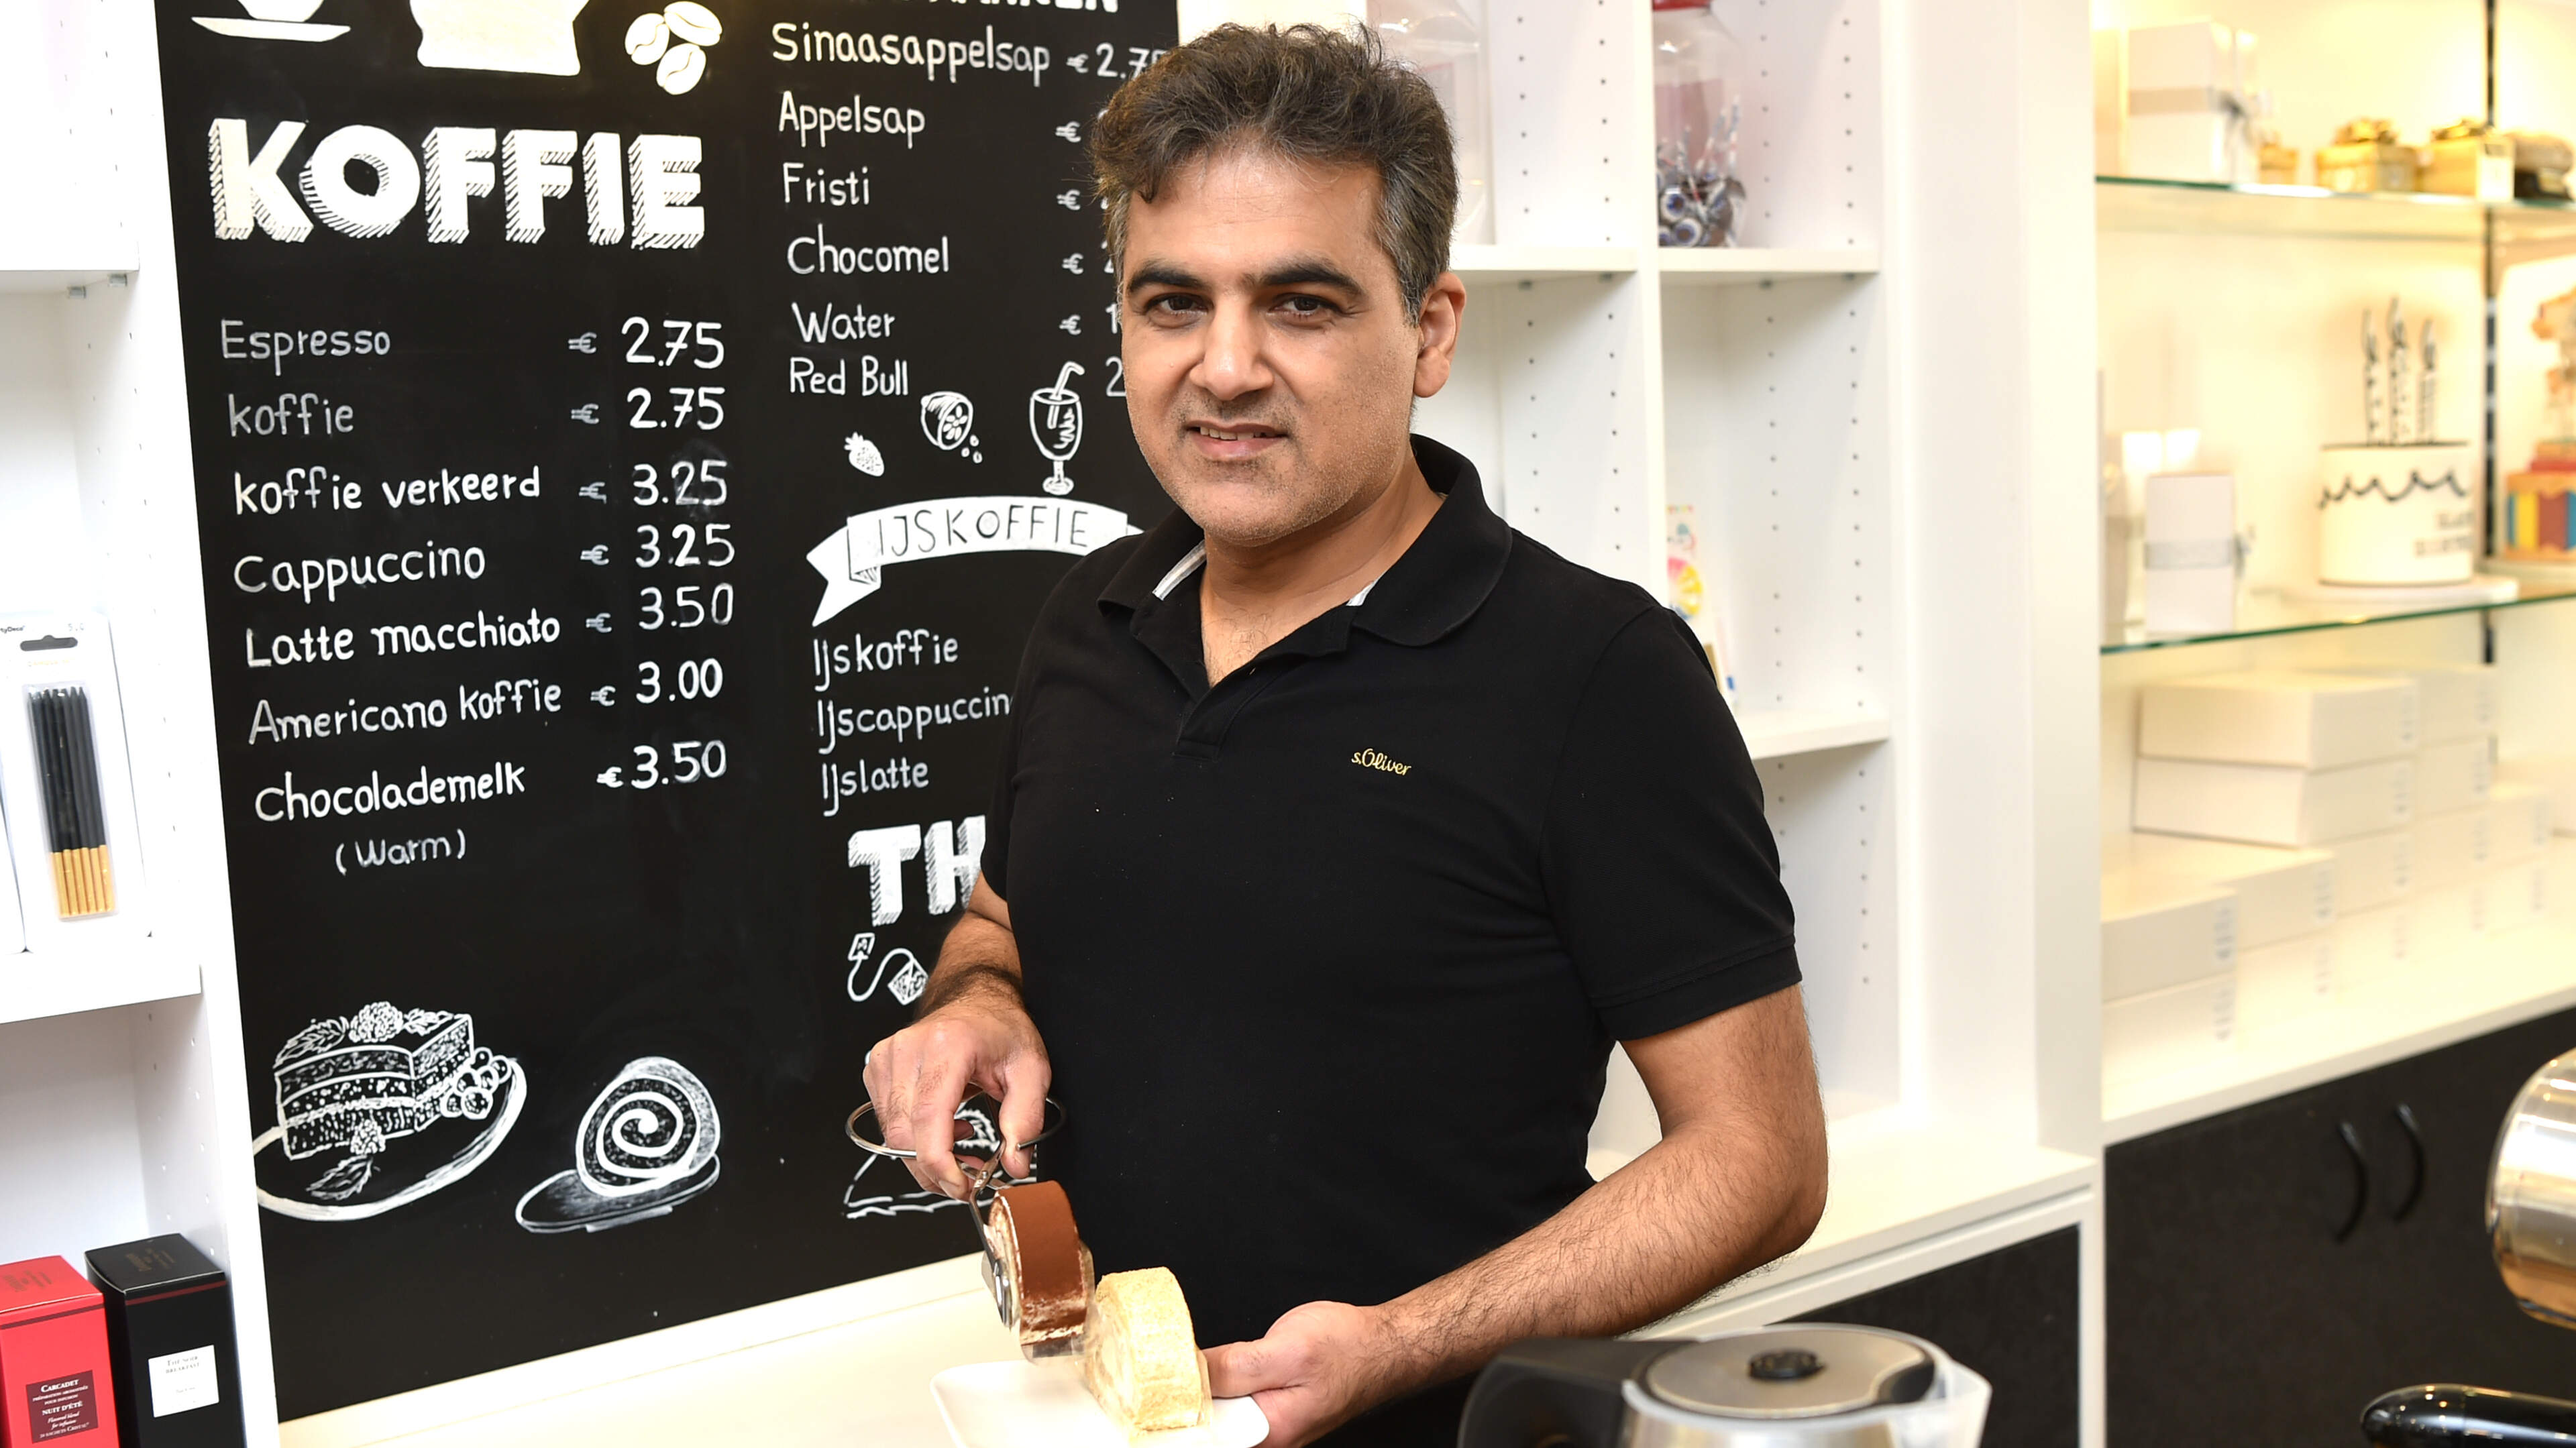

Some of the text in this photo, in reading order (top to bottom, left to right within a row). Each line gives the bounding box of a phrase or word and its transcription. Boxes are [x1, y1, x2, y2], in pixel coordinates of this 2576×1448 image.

[771, 21, 1050, 87] Sinaasappelsap
[778, 90, 925, 150] Appelsap
[207, 117, 705, 251] KOFFIE
[782, 162, 869, 207] Fristi
[787, 223, 949, 275] Chocomel
[221, 319, 390, 376] Espresso
[621, 316, 724, 370] 2.75
[791, 302, 896, 343] Water
[790, 355, 908, 396] Red Bull
[228, 393, 354, 437] koffie
[627, 386, 725, 431] 2.75
[234, 465, 362, 515] koffie
[381, 465, 540, 508] verkeerd
[633, 459, 727, 506] 3.25
[877, 504, 1089, 557] IJSKOFFIE
[233, 540, 486, 604] Cappuccino
[635, 522, 735, 568] 3.25
[246, 626, 355, 668] Latte
[370, 608, 560, 656] macchiato
[639, 582, 734, 630] 3.50
[248, 698, 447, 745] Americano
[459, 679, 561, 720] koffie
[636, 658, 723, 704] 3.00
[255, 761, 525, 822] Chocolademelk
[631, 740, 727, 789] 3.50
[847, 813, 987, 928] TH
